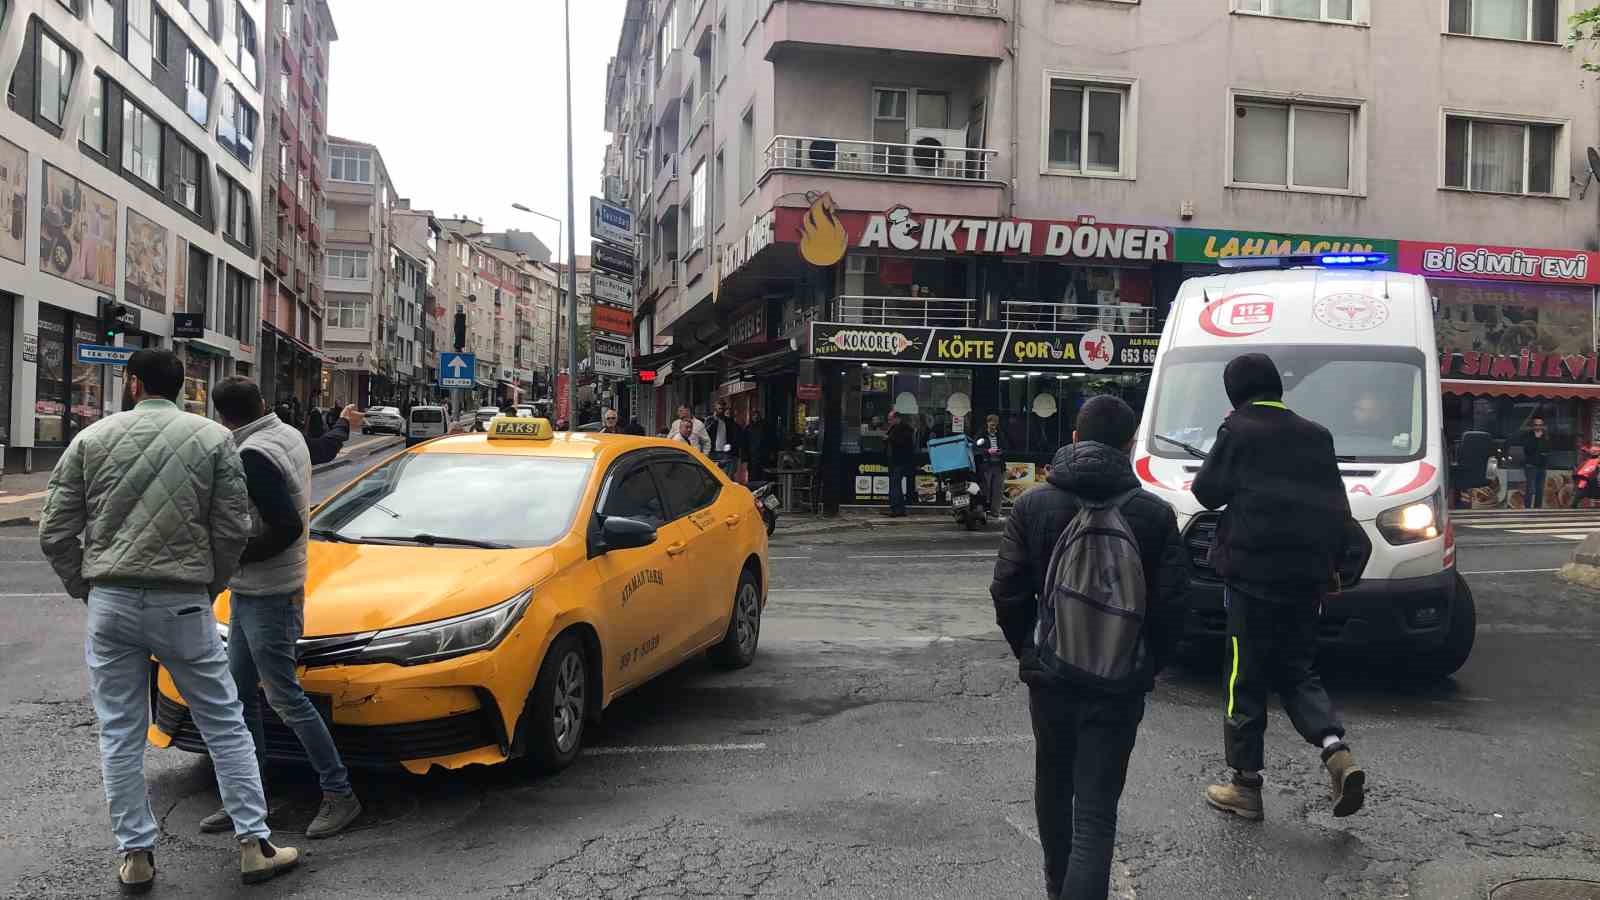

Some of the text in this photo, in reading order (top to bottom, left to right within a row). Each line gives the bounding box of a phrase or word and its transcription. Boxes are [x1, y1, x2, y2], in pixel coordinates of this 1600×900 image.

[1045, 215, 1169, 260] DÖNER
[1238, 304, 1266, 316] 112
[843, 334, 897, 355] KOKOREÇ
[938, 335, 994, 360] KÖFTE
[87, 350, 125, 359] TEK YÖN
[1121, 348, 1140, 363] 653
